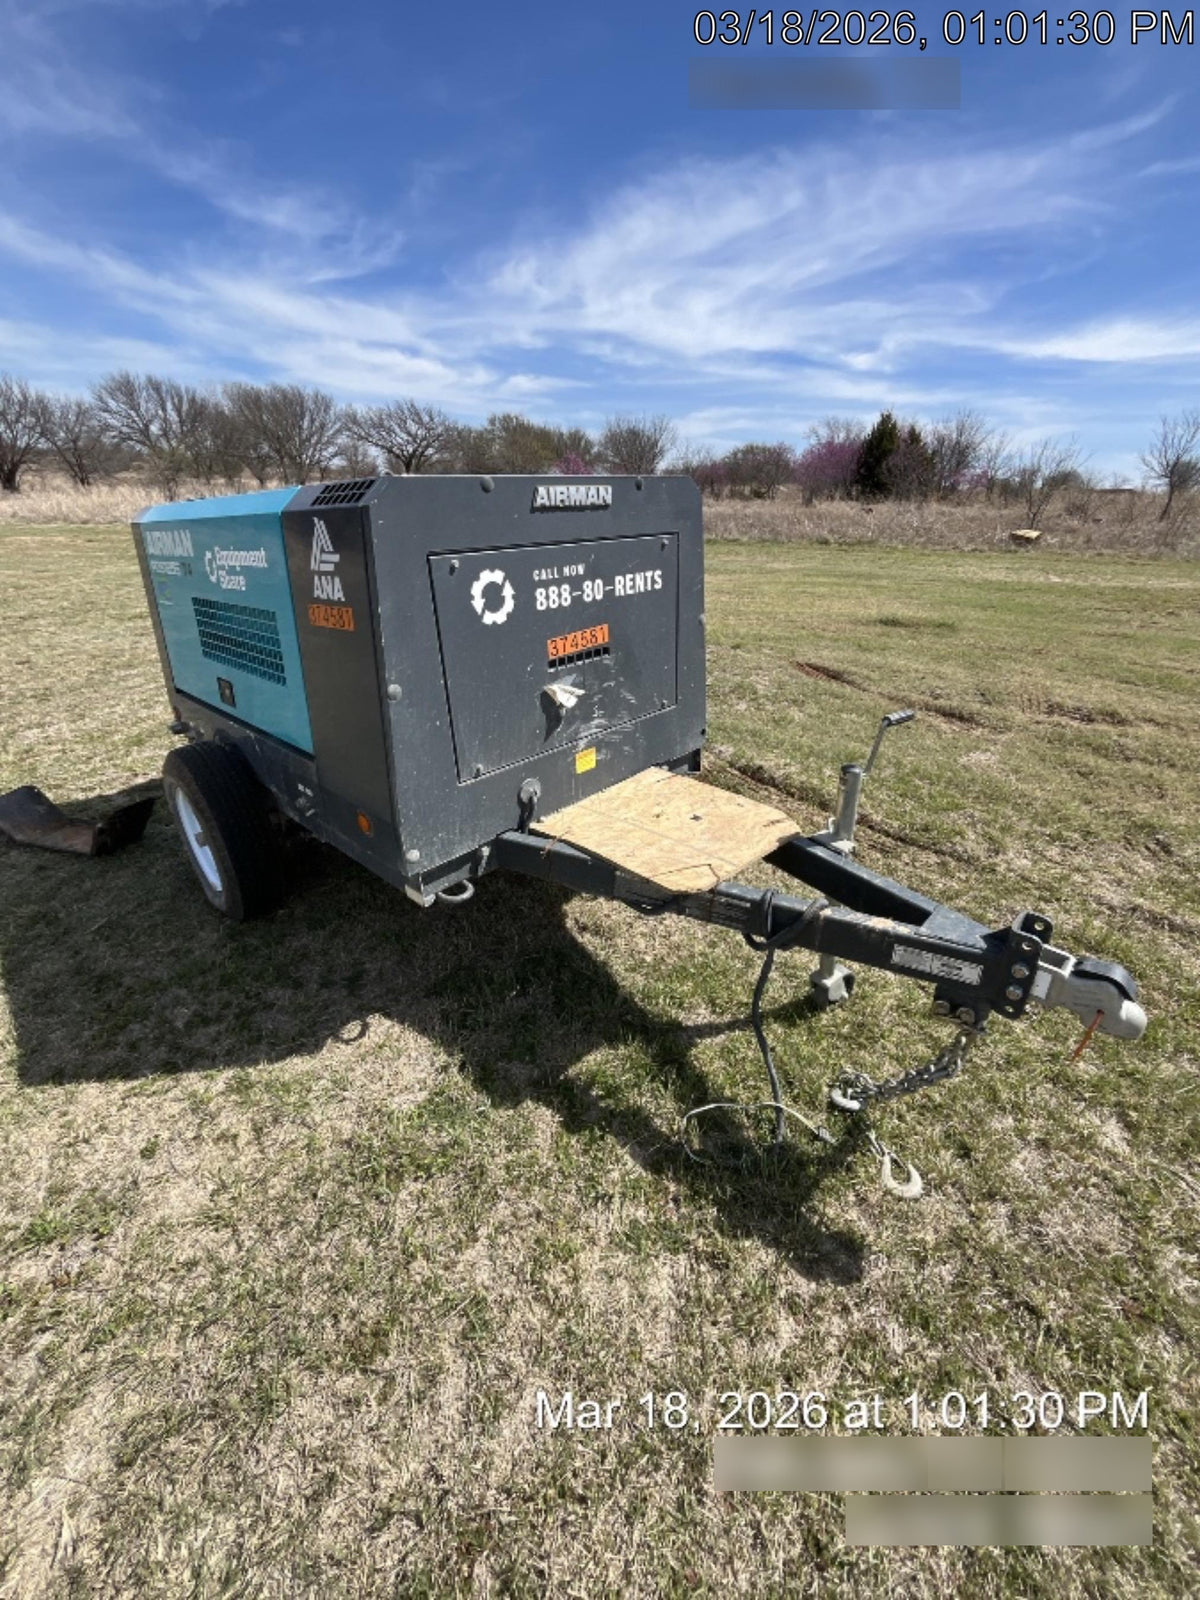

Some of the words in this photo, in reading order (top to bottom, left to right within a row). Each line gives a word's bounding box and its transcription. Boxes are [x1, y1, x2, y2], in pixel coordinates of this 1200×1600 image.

[535, 485, 612, 507] AIRMAN
[214, 546, 268, 571] Equipment
[219, 570, 246, 590] Share
[533, 567, 559, 581] CALL
[563, 563, 585, 577] NOW
[314, 575, 345, 601] ANA
[535, 569, 662, 610] 888-80-RENTS
[310, 605, 353, 629] 374581
[550, 626, 607, 657] 374581
